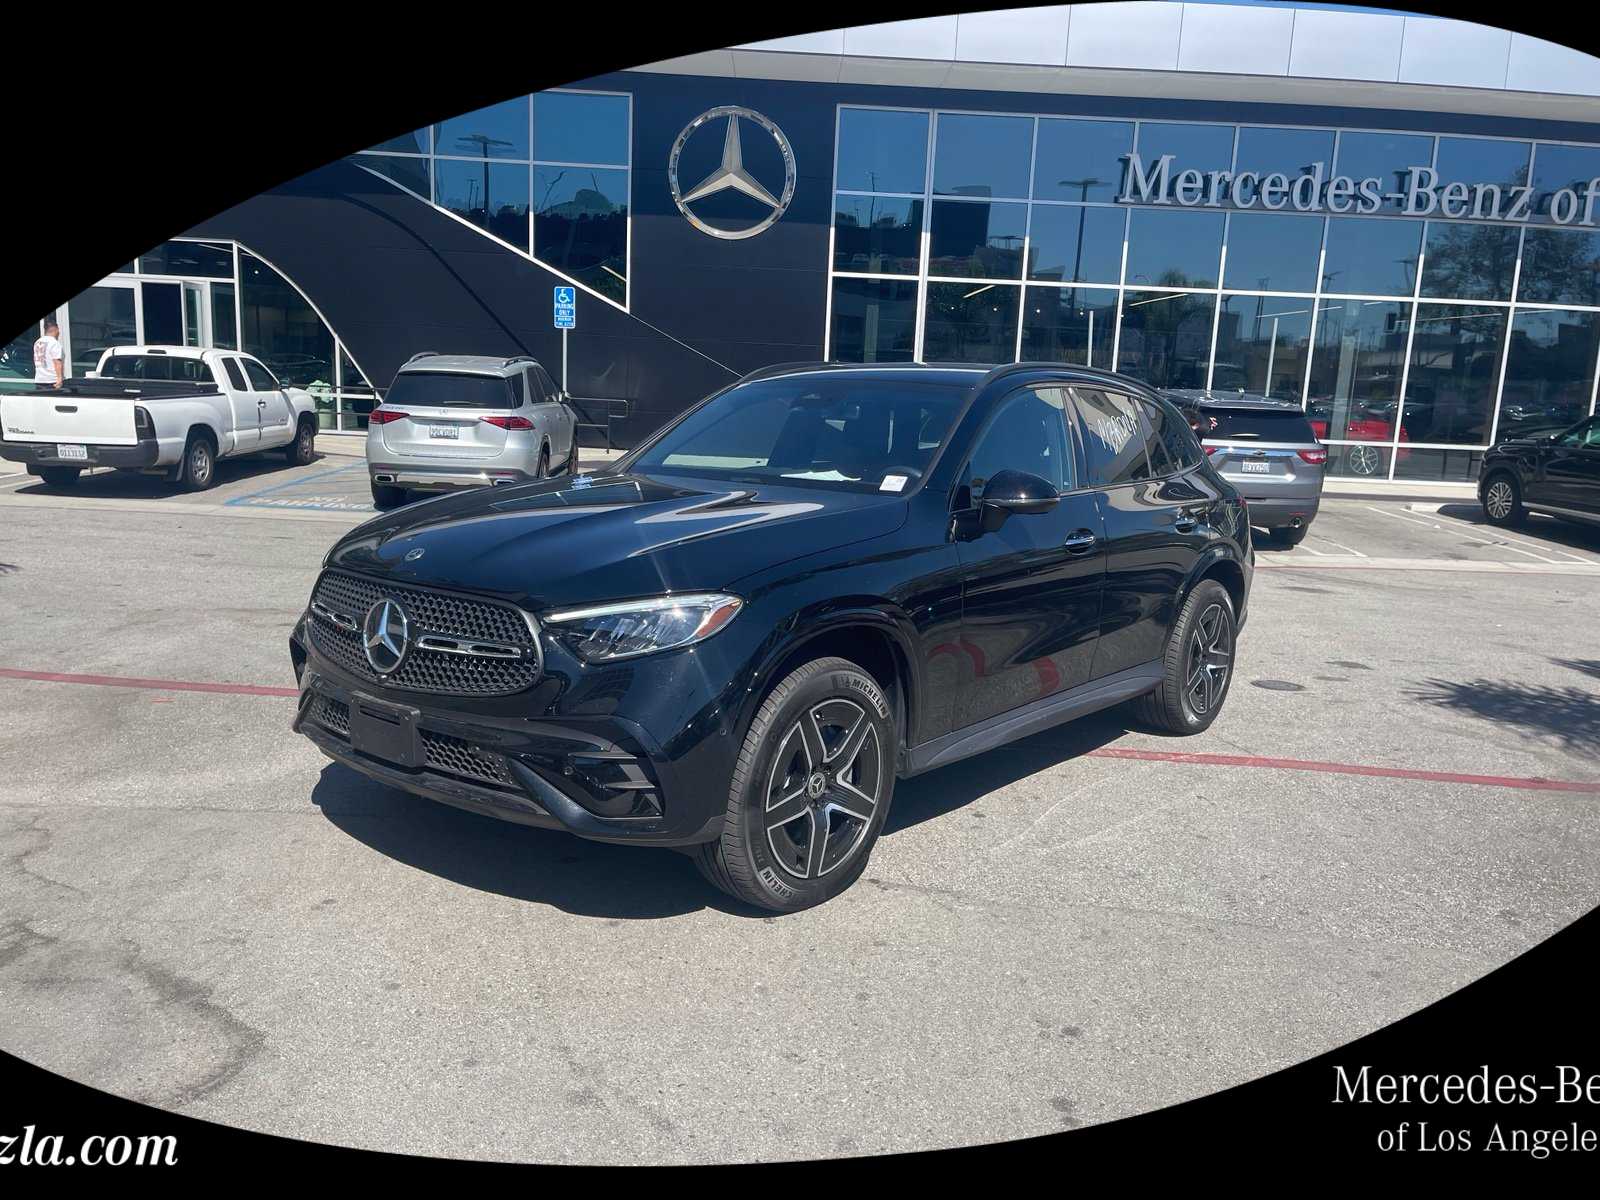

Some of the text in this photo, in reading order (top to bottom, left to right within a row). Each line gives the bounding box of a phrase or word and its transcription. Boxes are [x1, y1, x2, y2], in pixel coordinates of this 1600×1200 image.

[1118, 152, 1600, 227] Mercedes-Benz of
[851, 679, 888, 717] MICHELIN
